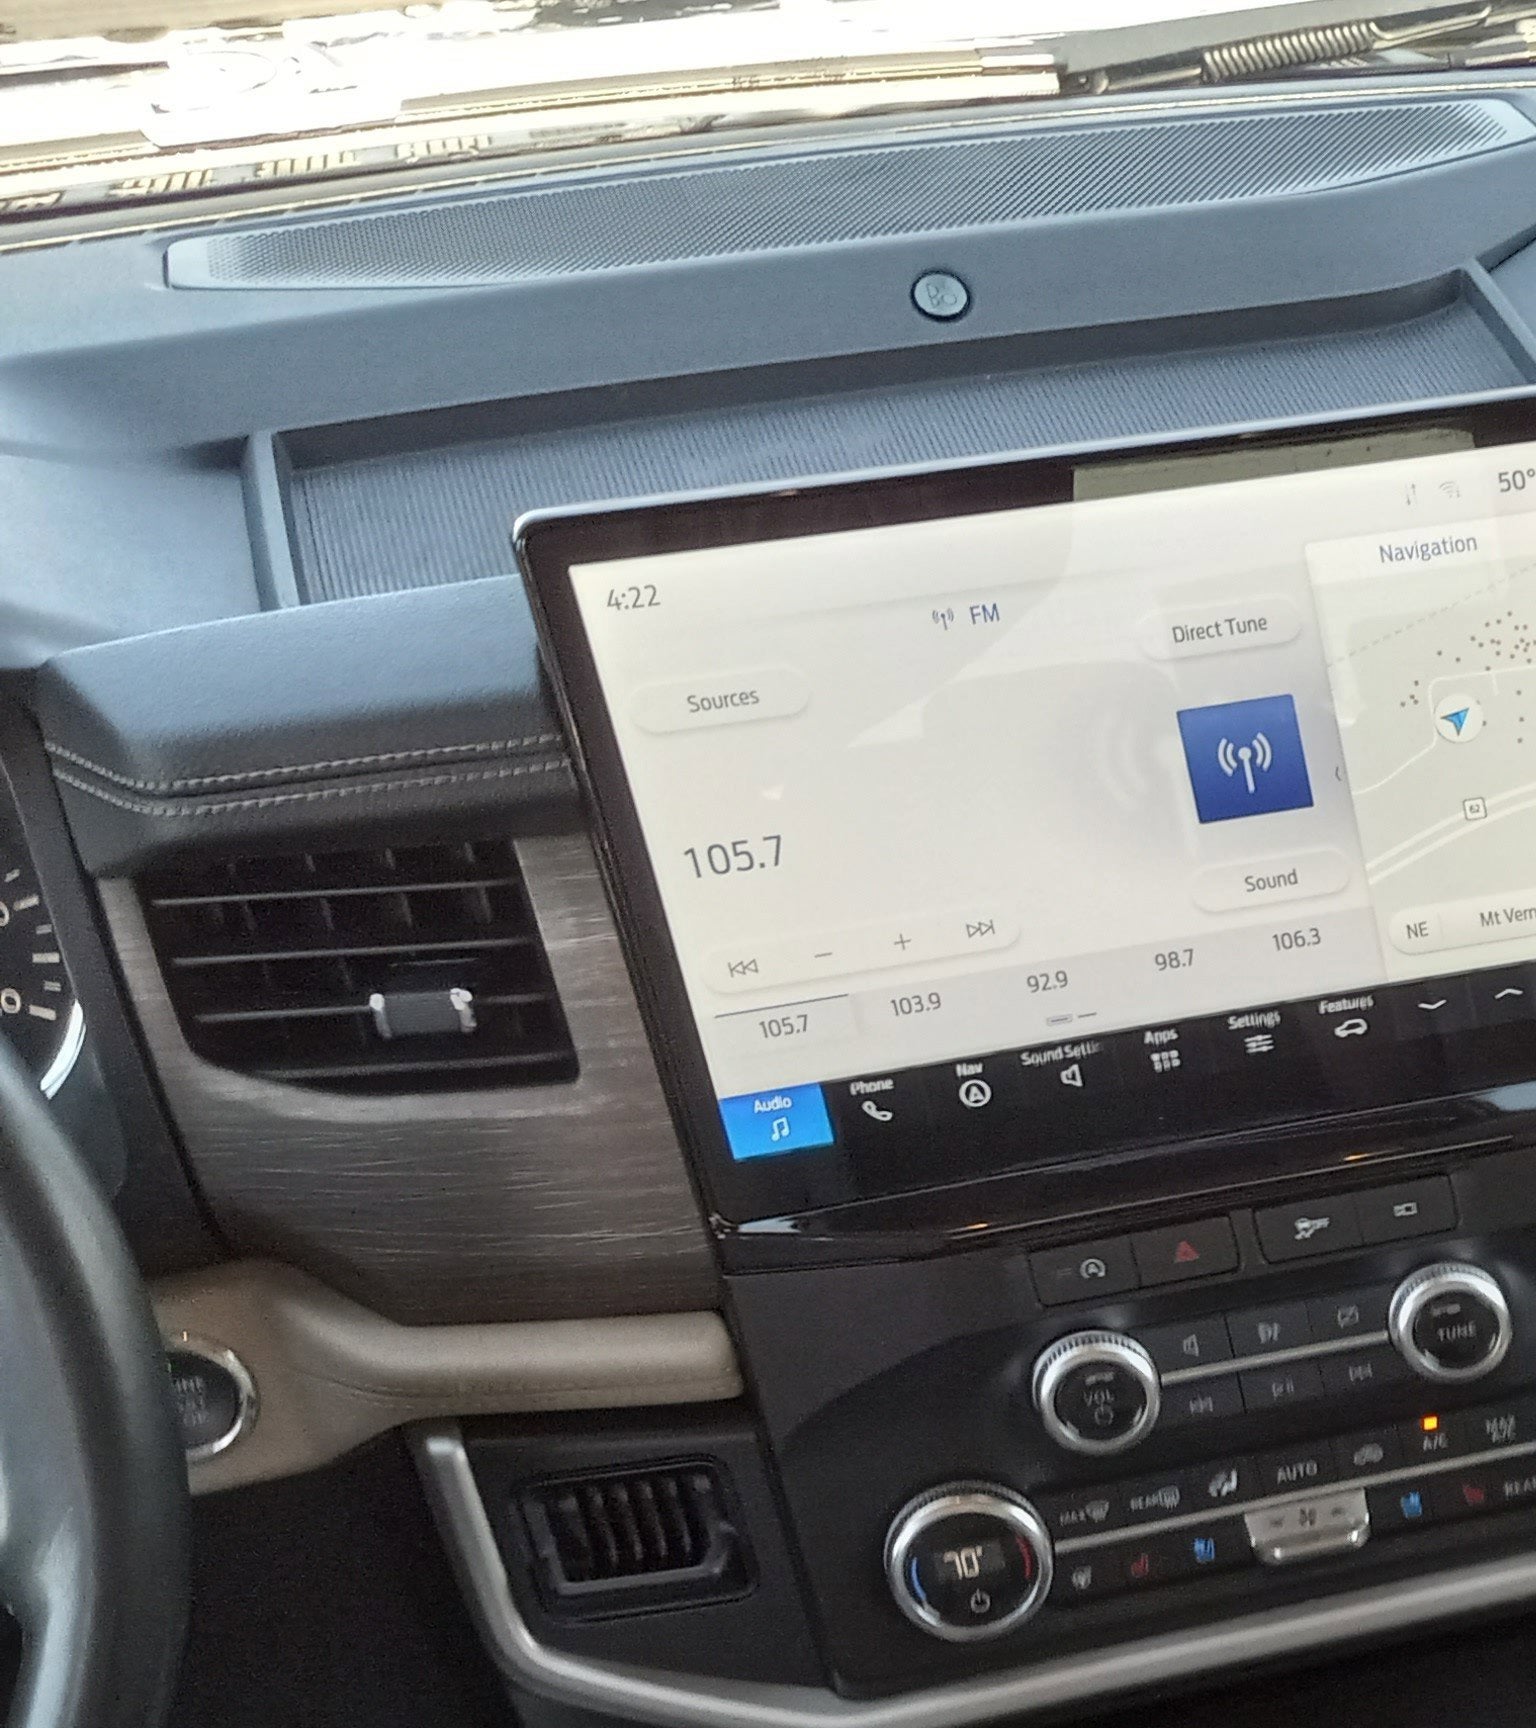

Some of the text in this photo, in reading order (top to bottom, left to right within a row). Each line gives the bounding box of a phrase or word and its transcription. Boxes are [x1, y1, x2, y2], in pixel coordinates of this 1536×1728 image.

[1498, 467, 1536, 493] 50°
[1378, 534, 1478, 564] Navigation
[606, 584, 661, 611] 4:22
[969, 602, 1001, 626] FM
[1171, 615, 1268, 644] Direct Tune
[686, 688, 760, 714] Sources
[683, 834, 783, 880] 105.7
[1244, 867, 1299, 893] Sound
[1405, 921, 1429, 940] NE
[1479, 908, 1500, 928] Mt
[758, 927, 1322, 1040] 105.7 103.9 92.9 98.7 106.3
[1318, 995, 1375, 1016] Features
[1228, 1009, 1282, 1031] Settings
[1143, 1028, 1179, 1047] Apps
[955, 1060, 984, 1077] Nav
[849, 1077, 894, 1096] Phone
[753, 1094, 793, 1114] Audio
[1276, 1459, 1319, 1484] AUTO
